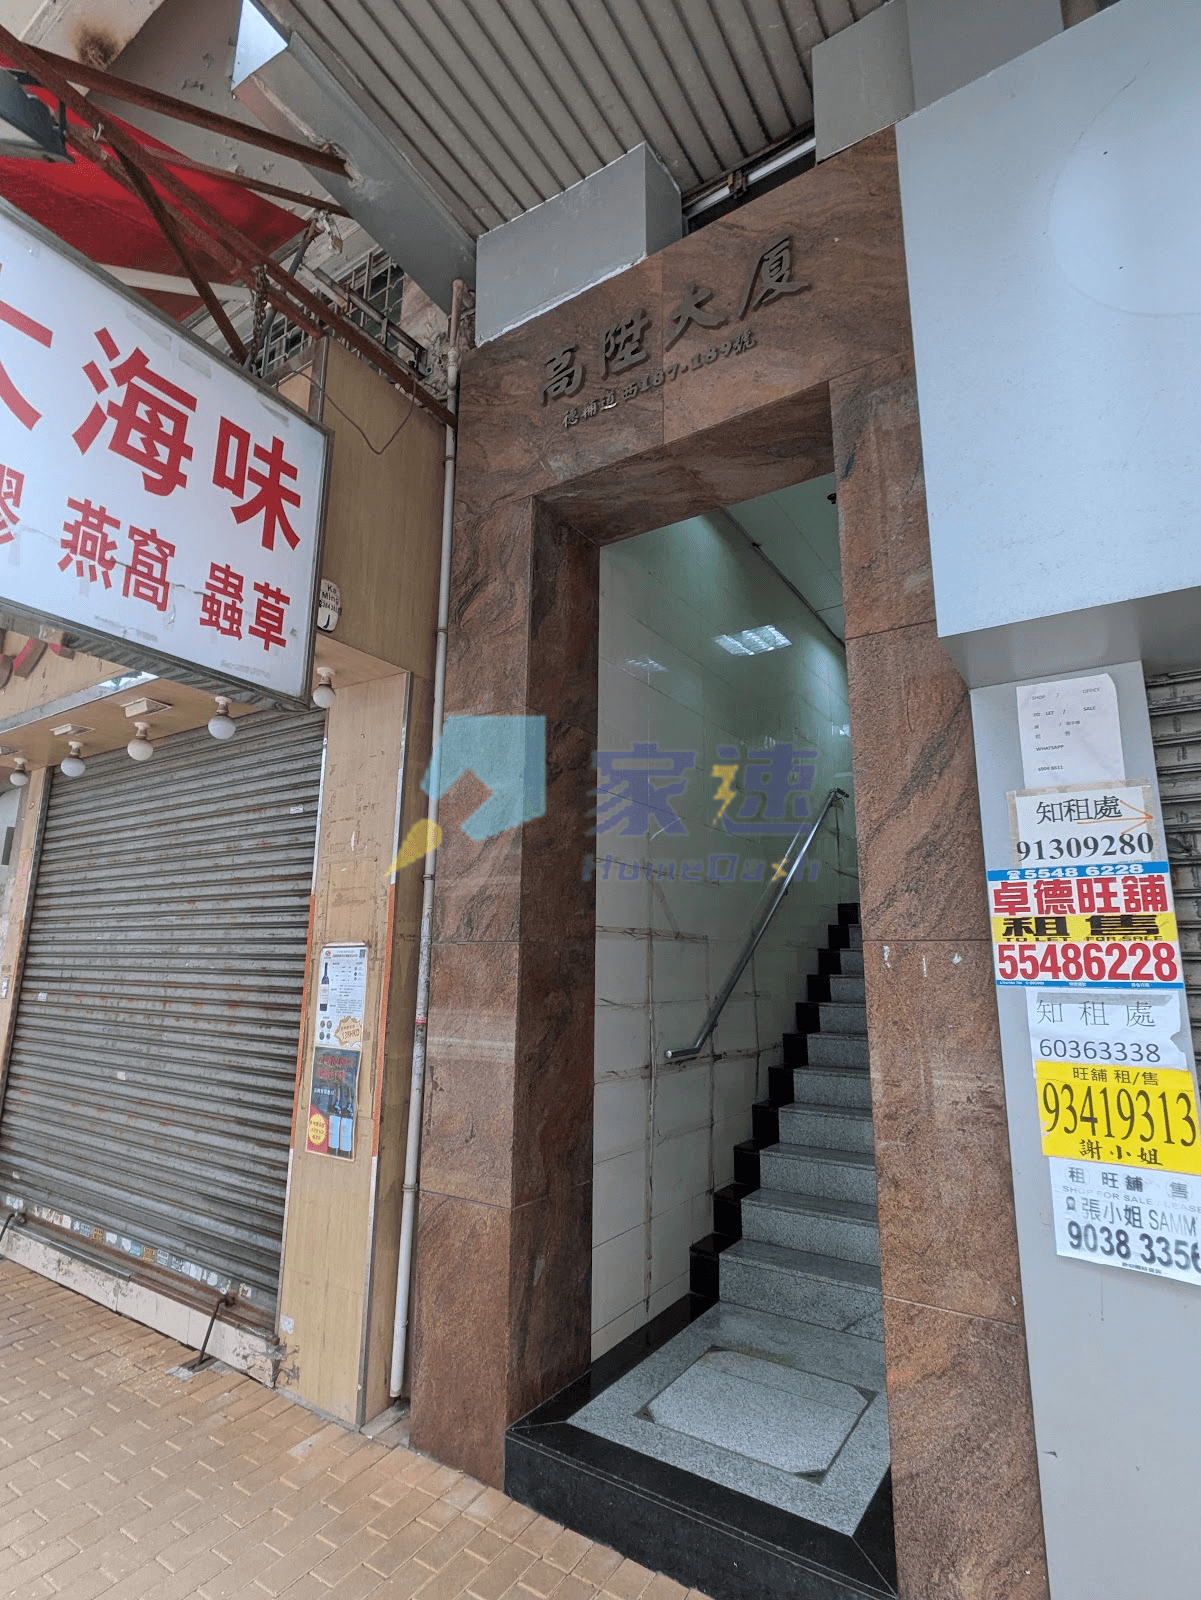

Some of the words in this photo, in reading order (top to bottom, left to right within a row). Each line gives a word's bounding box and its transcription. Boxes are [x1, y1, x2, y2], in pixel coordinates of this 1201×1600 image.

[58, 496, 176, 613] 燕窩
[199, 561, 291, 652] 蟲草
[1035, 744, 1065, 752] WHATSAPP
[1035, 795, 1123, 825] 知租處
[1015, 831, 1154, 862] 91309280
[1024, 866, 1079, 880] 5548
[1085, 863, 1145, 876] 6228
[993, 874, 1169, 916] 卓德旺舖
[1002, 915, 1070, 937] 租
[1085, 914, 1160, 936] 售
[997, 942, 1178, 982] 55486228
[1039, 1038, 1161, 1063] 60363338
[1072, 1067, 1108, 1083] 旺舖
[1042, 1081, 1197, 1148] 93419313
[1079, 1139, 1164, 1166] 謝小姐
[1062, 1185, 1093, 1196] SHOP
[1096, 1190, 1120, 1200] FOR
[1123, 1194, 1153, 1206] SALE
[1068, 1166, 1086, 1184] 租
[1169, 1181, 1188, 1200] 售
[1081, 1196, 1144, 1229] 張小姐
[1148, 1208, 1199, 1238] SAMM
[1067, 1220, 1132, 1260] 9038
